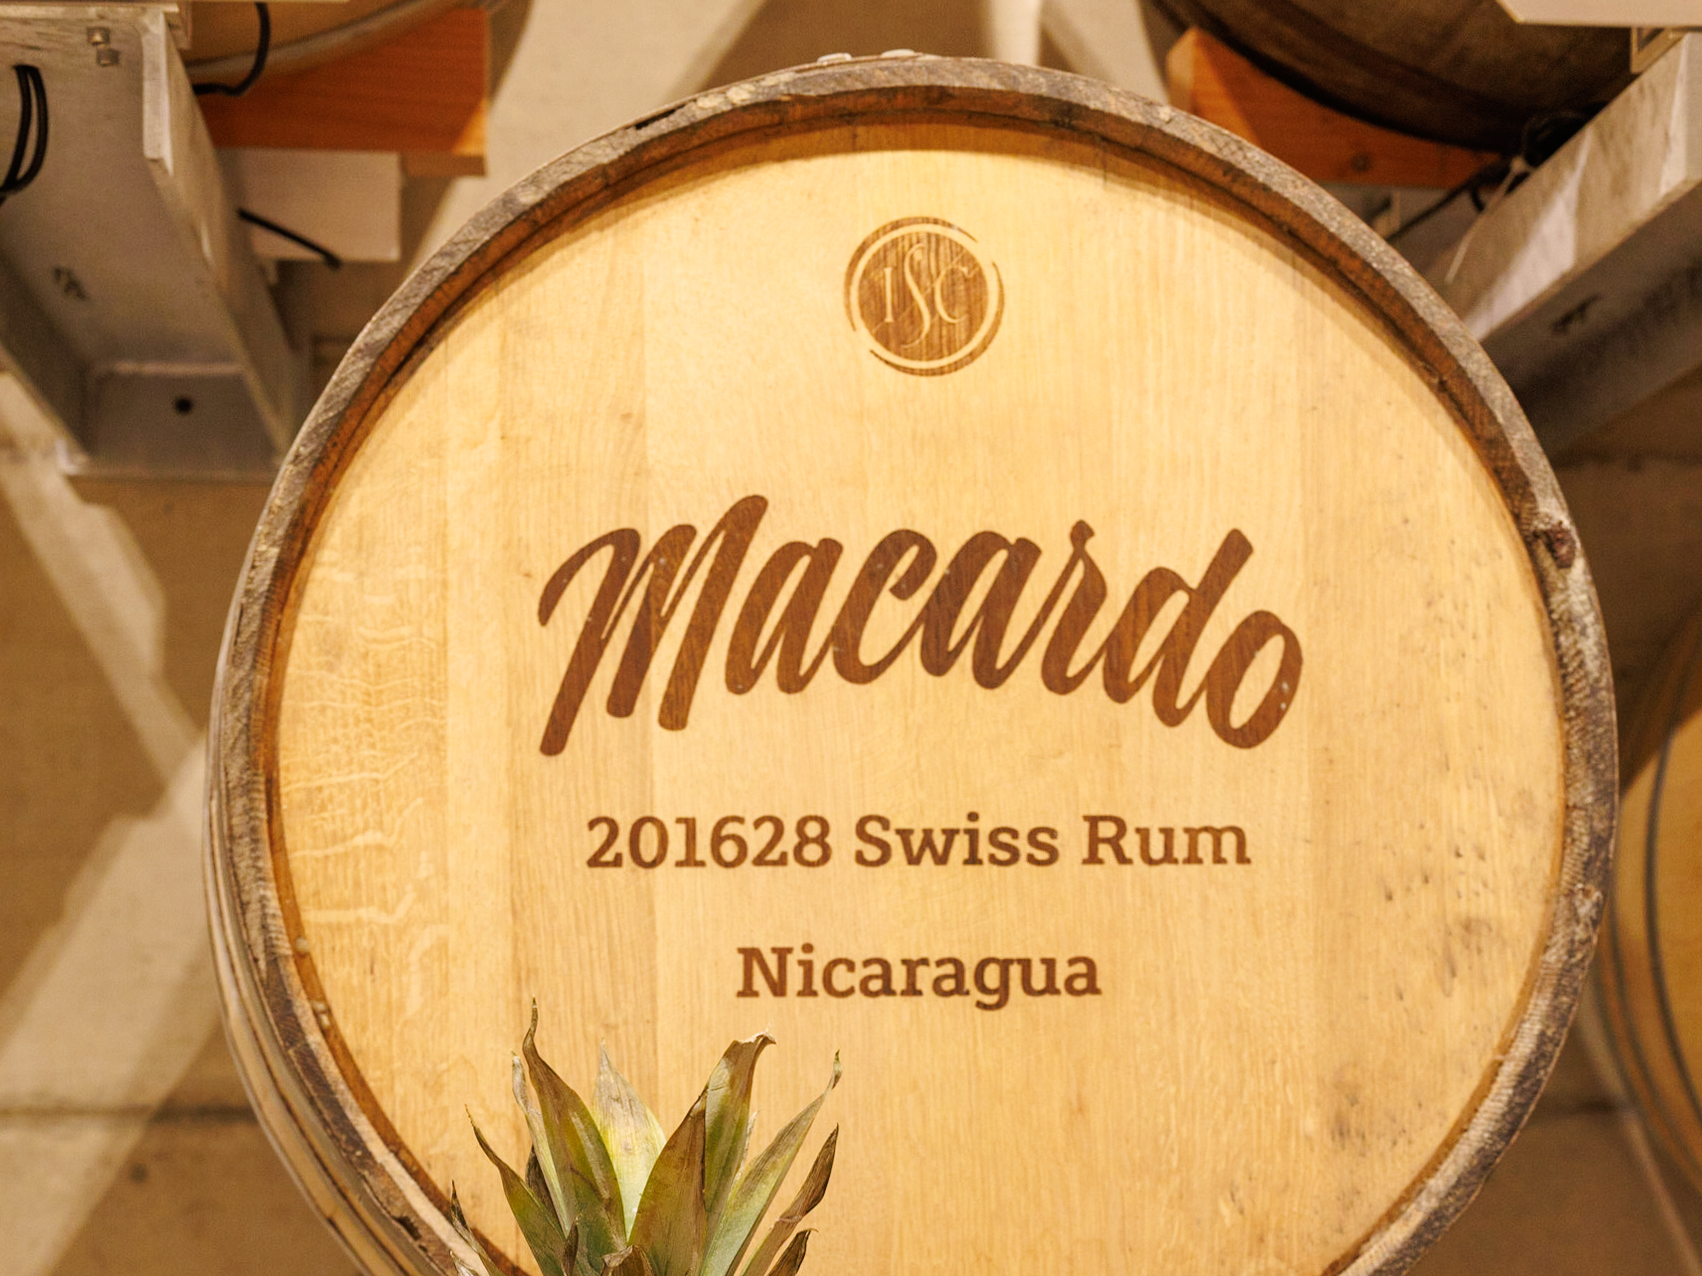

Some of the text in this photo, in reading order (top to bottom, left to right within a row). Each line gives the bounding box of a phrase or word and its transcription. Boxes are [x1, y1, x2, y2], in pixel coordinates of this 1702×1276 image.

[537, 494, 1303, 757] Macardo
[586, 812, 1251, 868] 201628 Swiss Rum
[736, 943, 1102, 1011] Nicaragua
